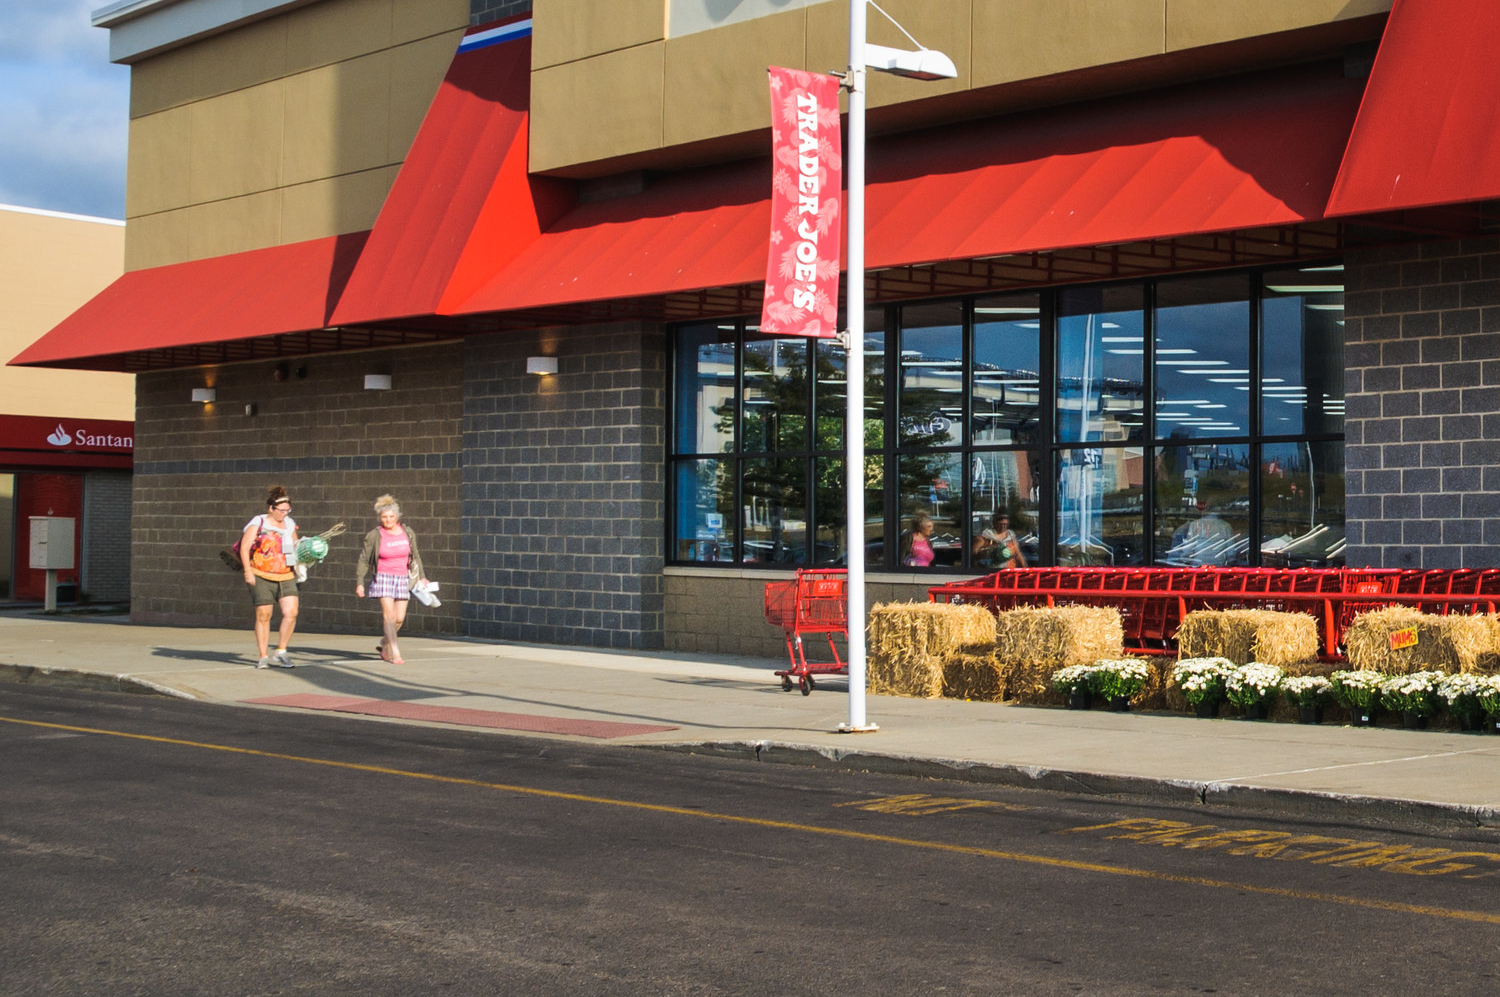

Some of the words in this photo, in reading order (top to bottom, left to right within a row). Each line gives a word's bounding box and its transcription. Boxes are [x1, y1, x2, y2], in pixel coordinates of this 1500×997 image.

[797, 92, 818, 215] TRADER
[793, 218, 818, 313] JOE'S
[75, 429, 133, 448] Santan
[1391, 628, 1417, 650] MUMS
